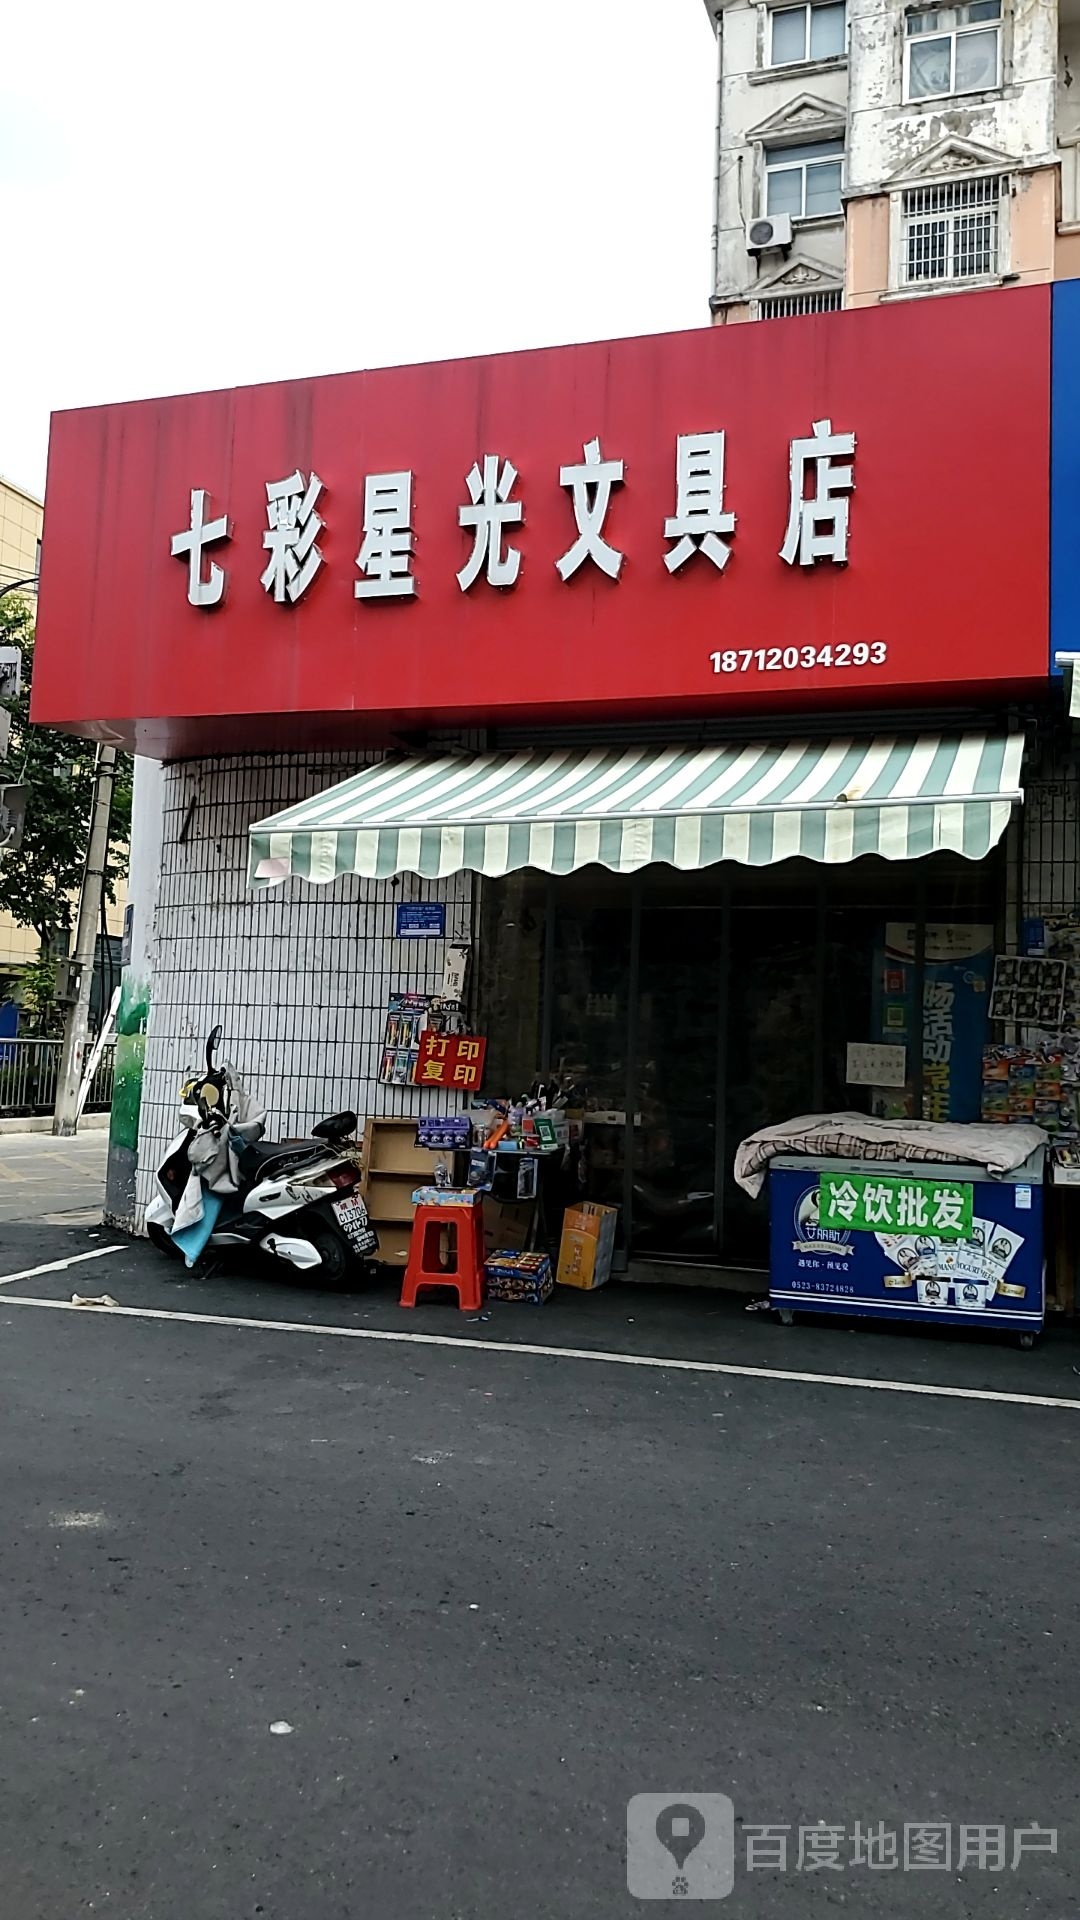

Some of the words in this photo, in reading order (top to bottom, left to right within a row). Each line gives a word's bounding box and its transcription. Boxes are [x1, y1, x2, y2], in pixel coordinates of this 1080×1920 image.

[171, 419, 857, 606] 七彩星光文具店
[709, 641, 887, 674] 18712034293
[426, 1035, 480, 1060] 打印
[421, 1060, 477, 1084] 复印
[828, 1180, 964, 1231] 冷饮批发
